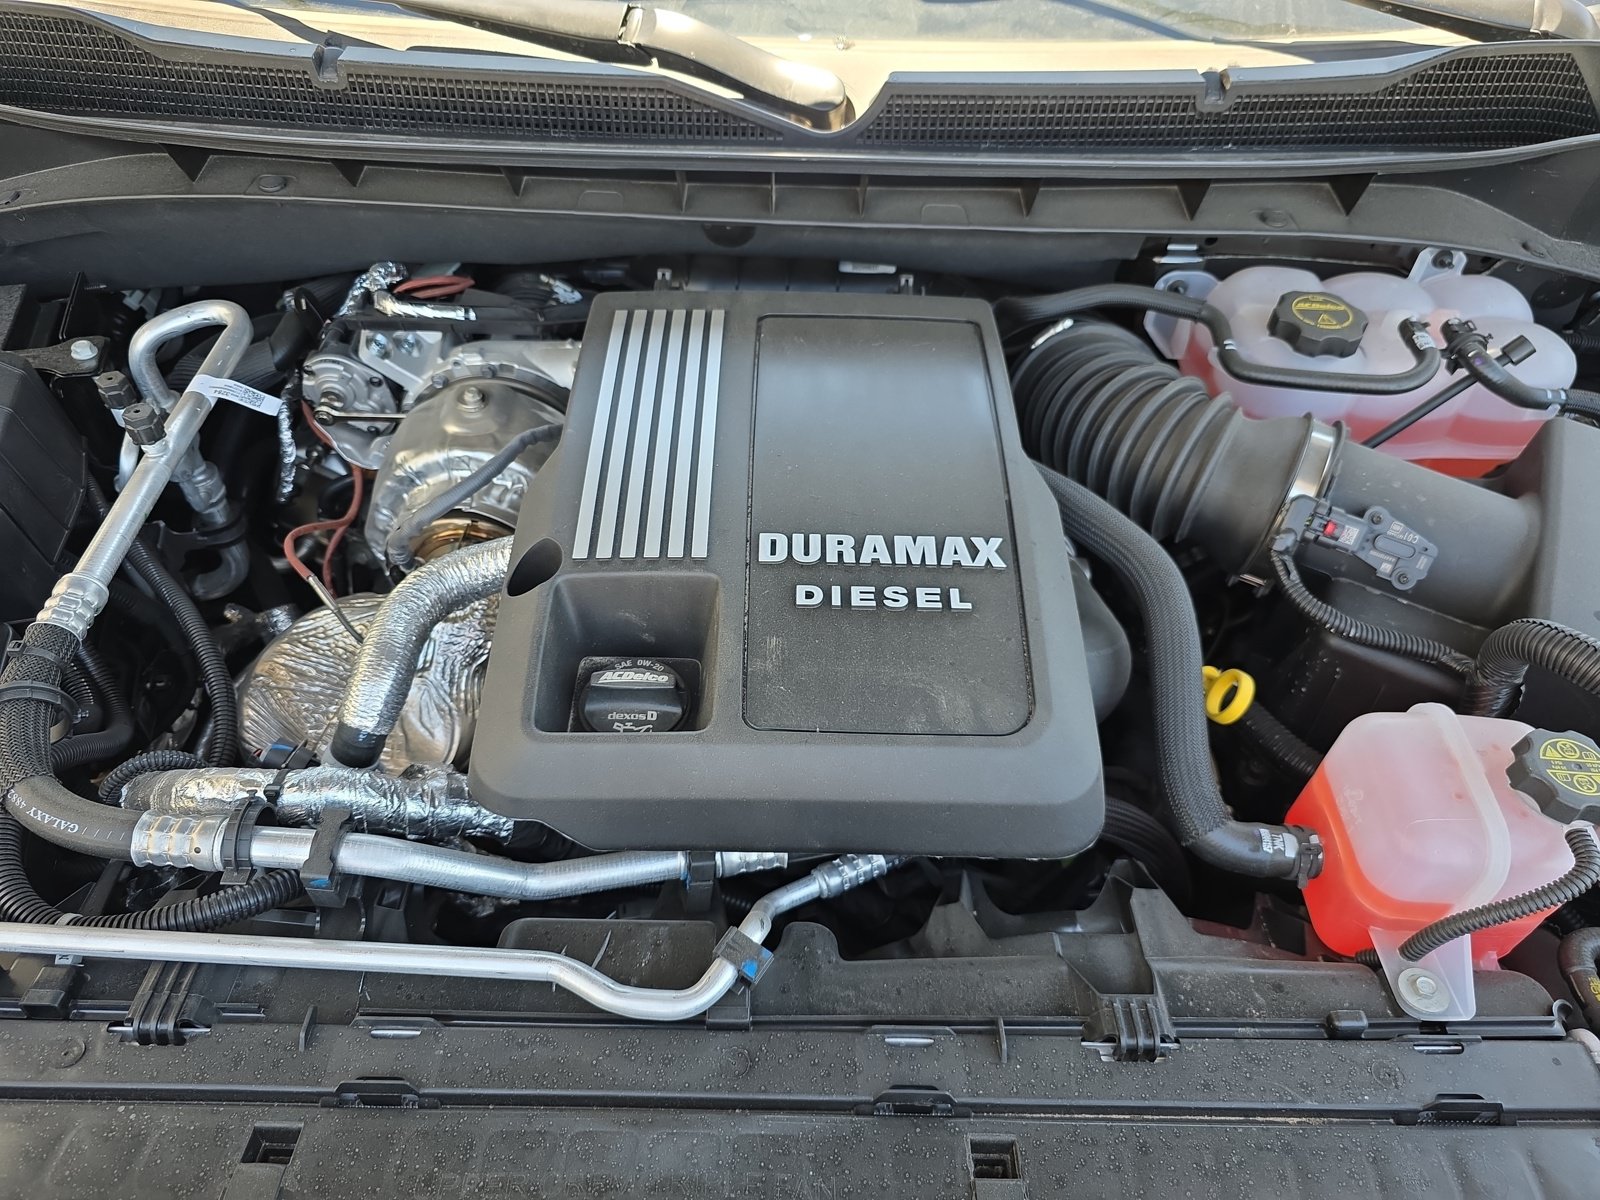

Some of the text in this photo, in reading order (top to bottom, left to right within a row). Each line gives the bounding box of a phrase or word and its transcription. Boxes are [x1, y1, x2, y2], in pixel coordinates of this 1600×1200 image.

[757, 532, 1008, 569] DURAMAX
[795, 584, 973, 611] DIESEL
[598, 671, 669, 683] ACDelco
[614, 659, 665, 672] SAE 0W-20
[7, 789, 79, 833] GALAXY 4882
